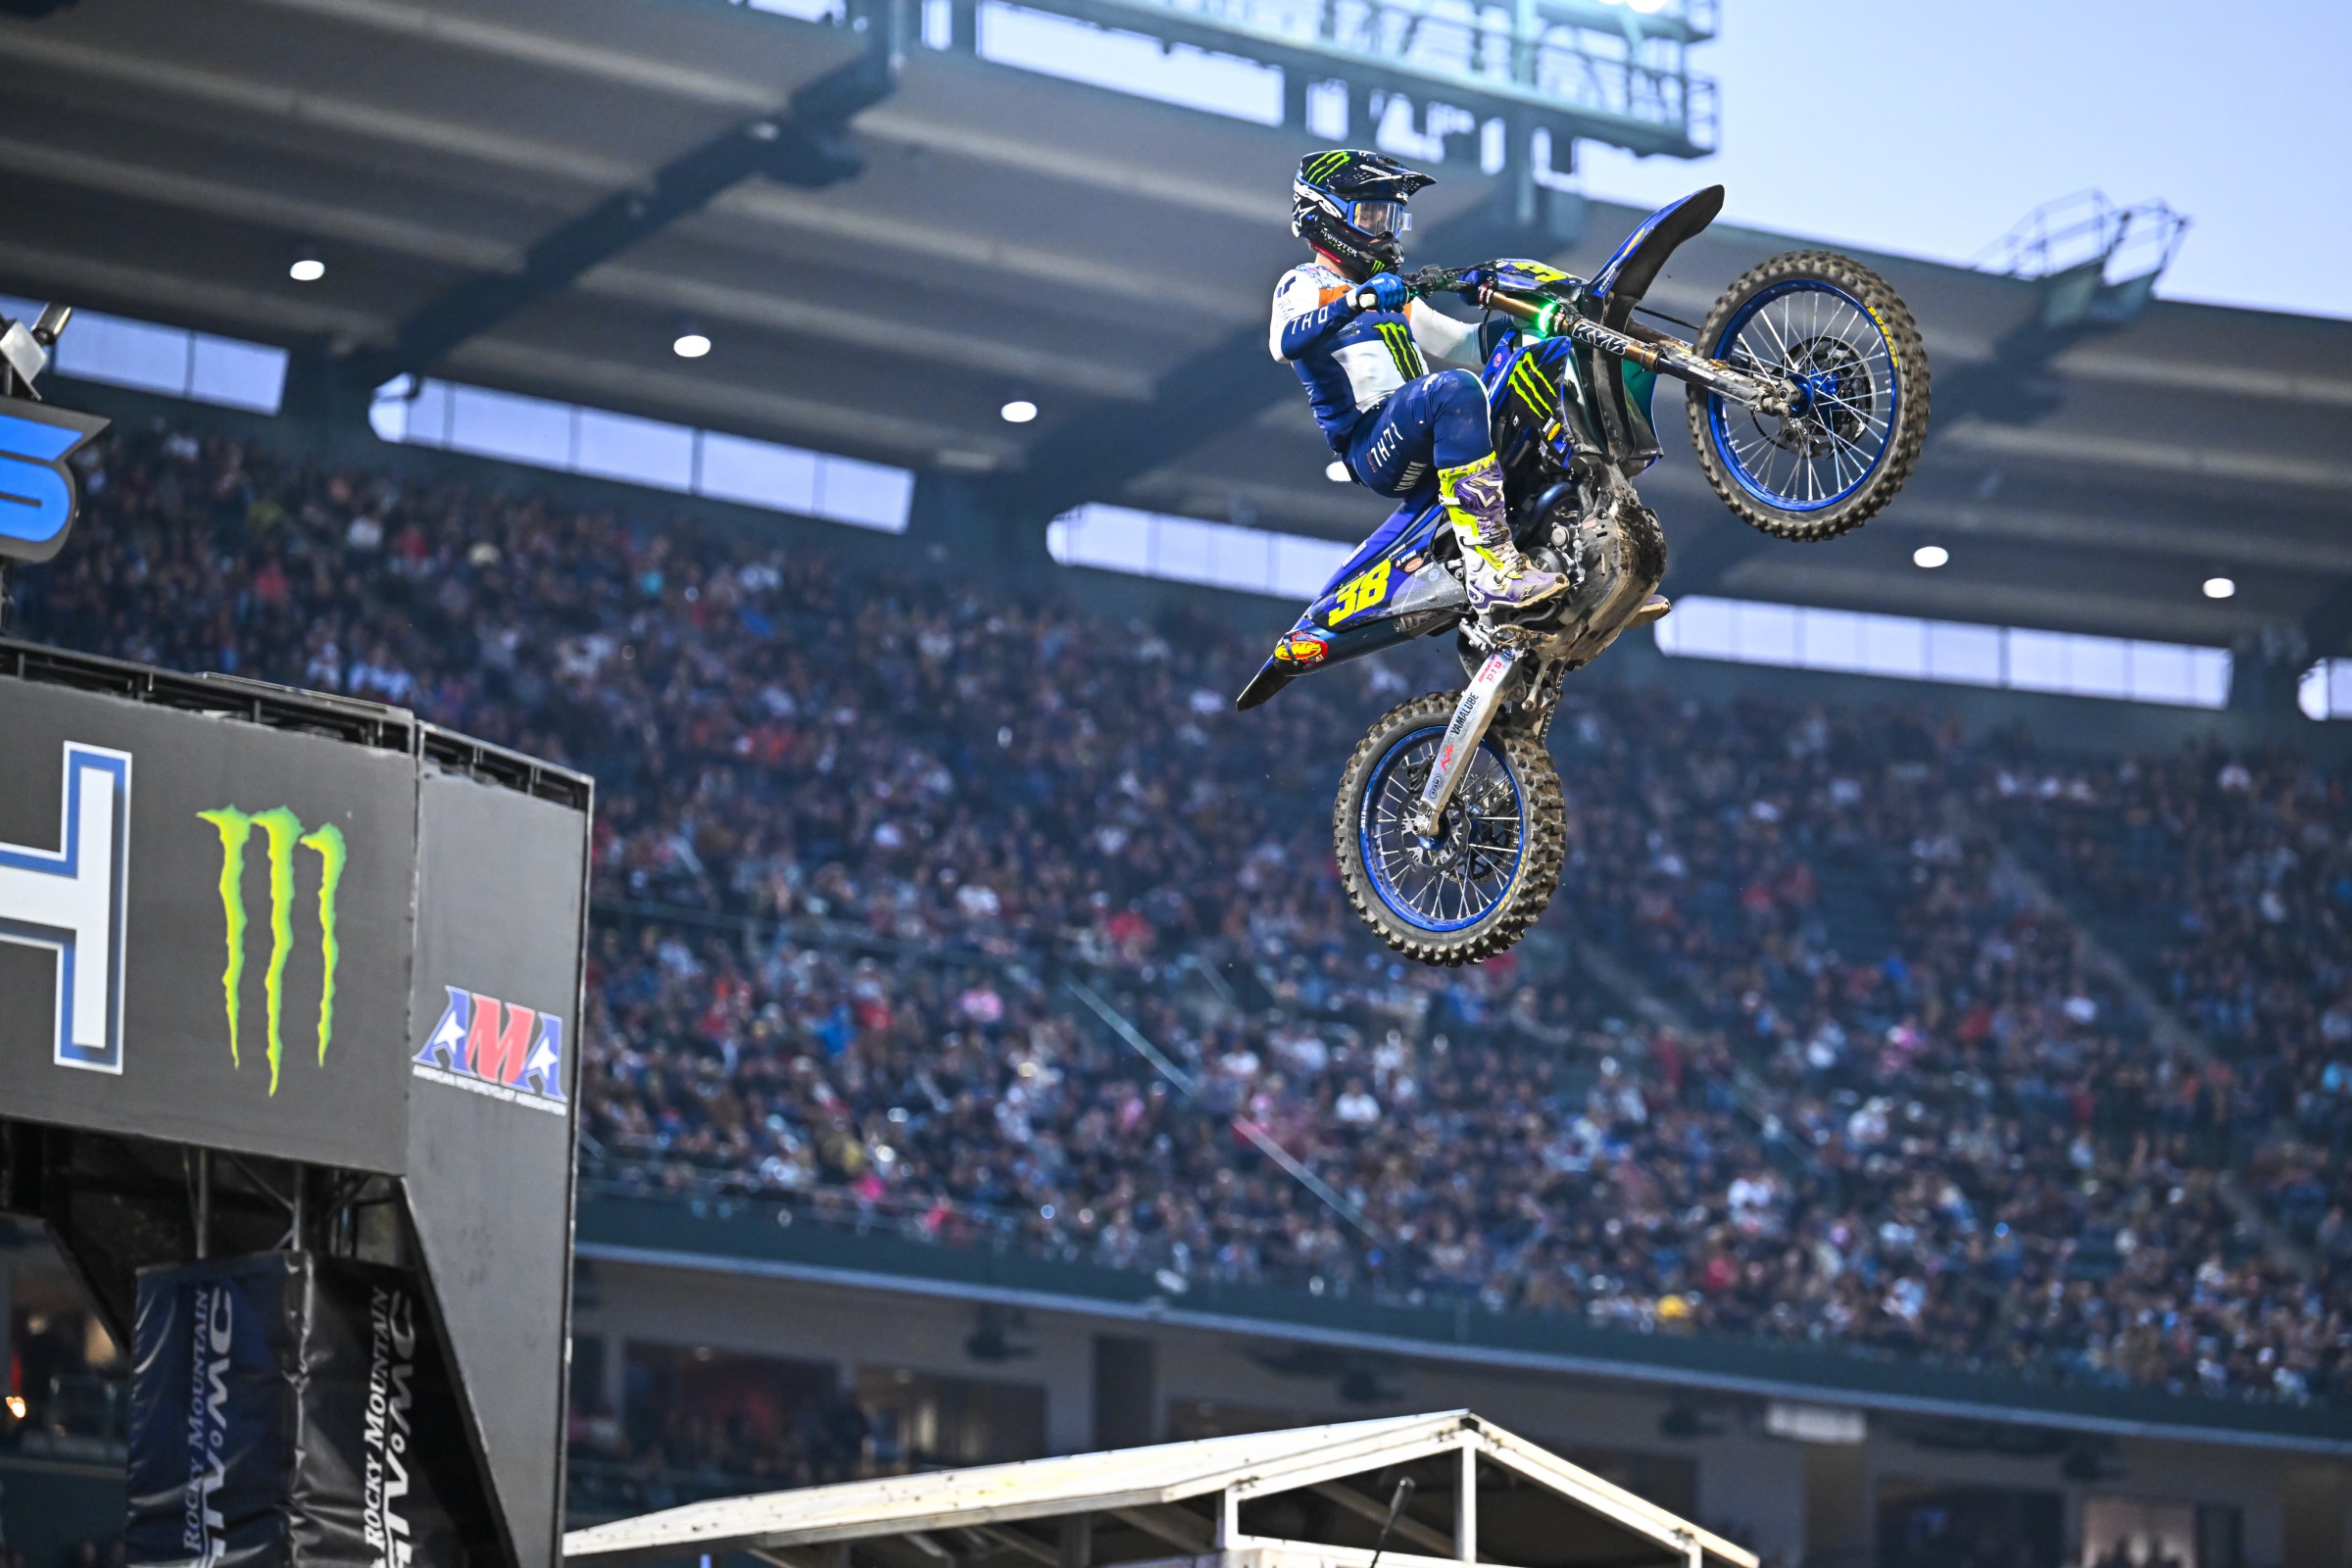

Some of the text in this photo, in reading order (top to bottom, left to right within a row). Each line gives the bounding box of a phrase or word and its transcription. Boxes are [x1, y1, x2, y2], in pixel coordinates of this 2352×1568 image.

[1320, 228, 1358, 258] MONSTER
[1571, 322, 1631, 355] KYB
[1867, 306, 1898, 368] DUNLOP
[1328, 557, 1392, 627] 38
[1450, 692, 1480, 736] YAMALUBE
[1497, 852, 1527, 911] DUNLOP
[412, 985, 568, 1102] AMA
[183, 1290, 210, 1553] ROCKY MOUNTAIN
[364, 1286, 389, 1553] ROCKY MOUNTAIN
